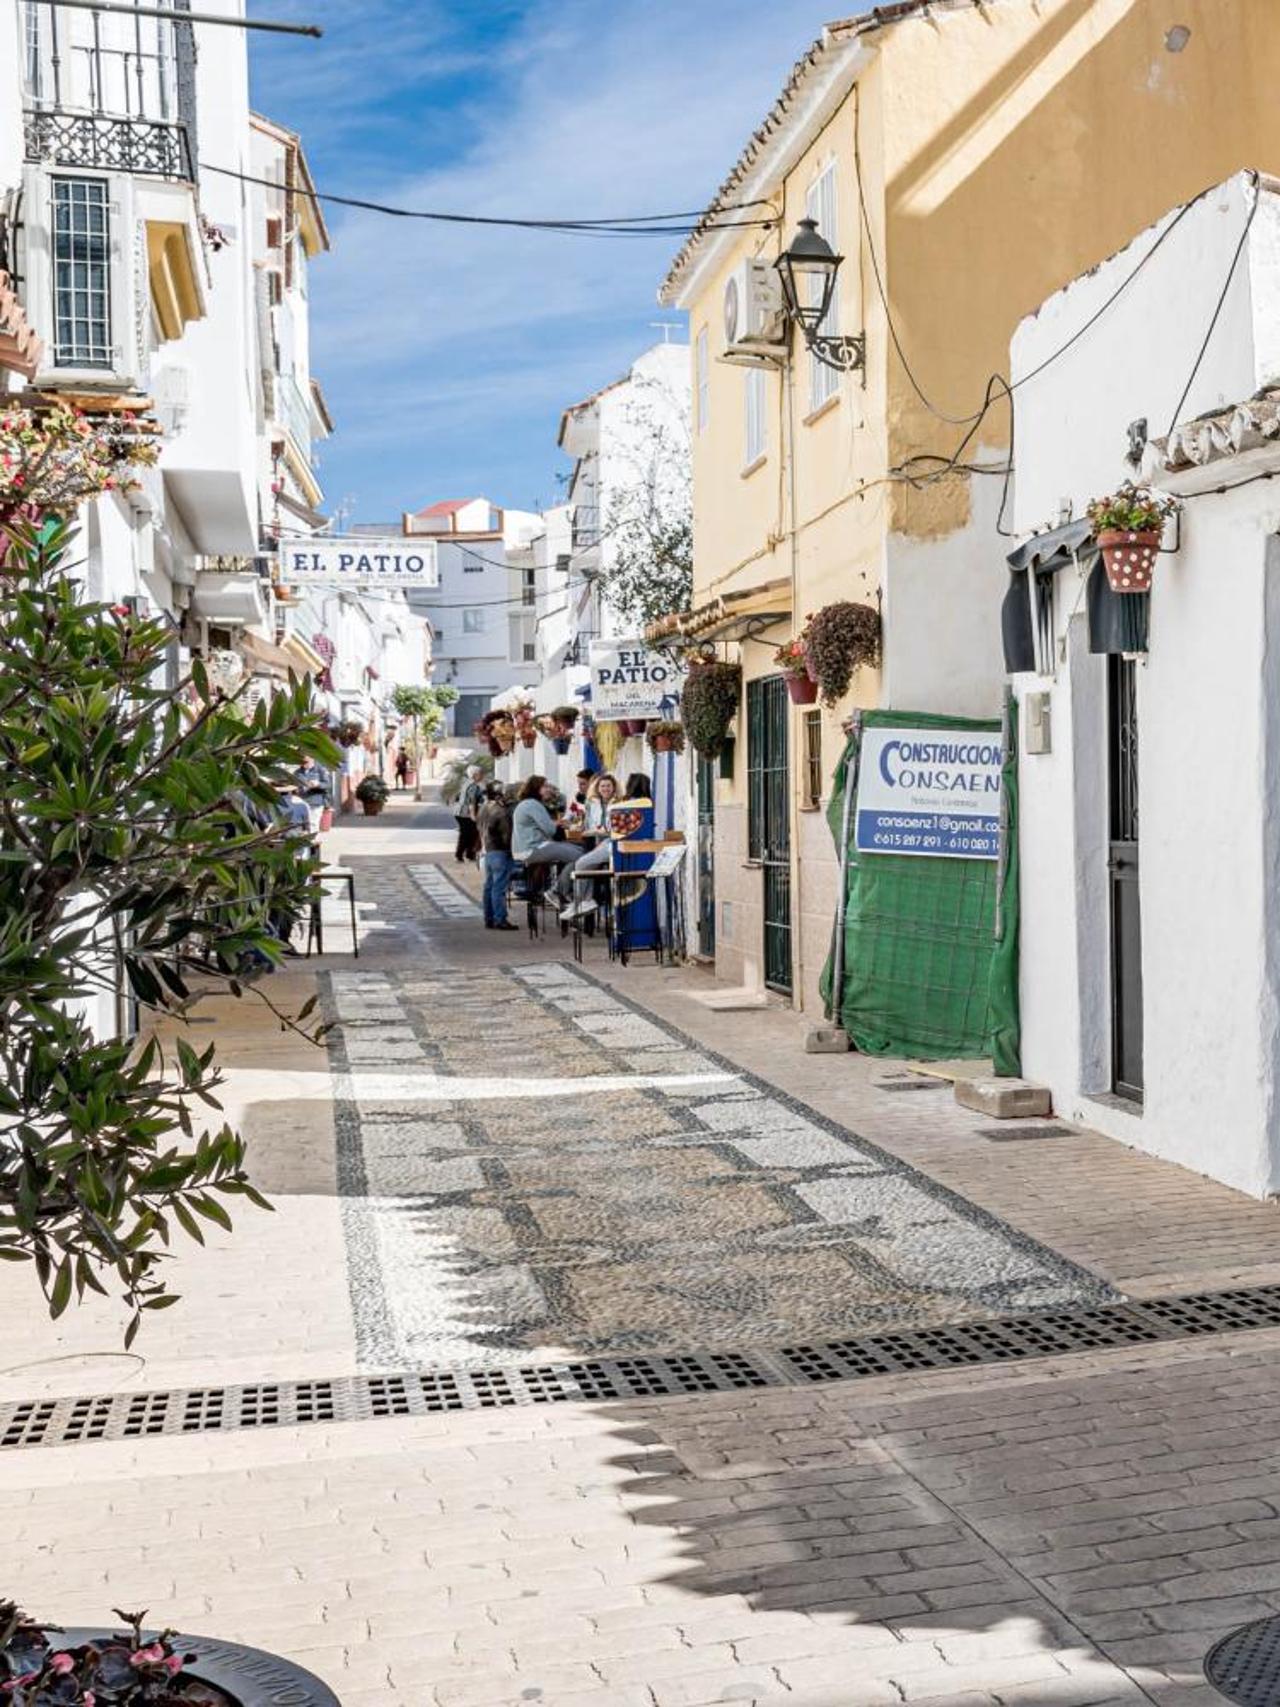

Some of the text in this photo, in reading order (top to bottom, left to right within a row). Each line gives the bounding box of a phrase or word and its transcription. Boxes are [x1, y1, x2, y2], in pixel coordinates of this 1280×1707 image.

[293, 553, 424, 573] EL PATIO
[618, 651, 646, 667] EL
[598, 666, 667, 685] PATIO
[880, 740, 1001, 787] CONSTRUCCION
[877, 816, 1001, 834] consaenz1@gmail.co
